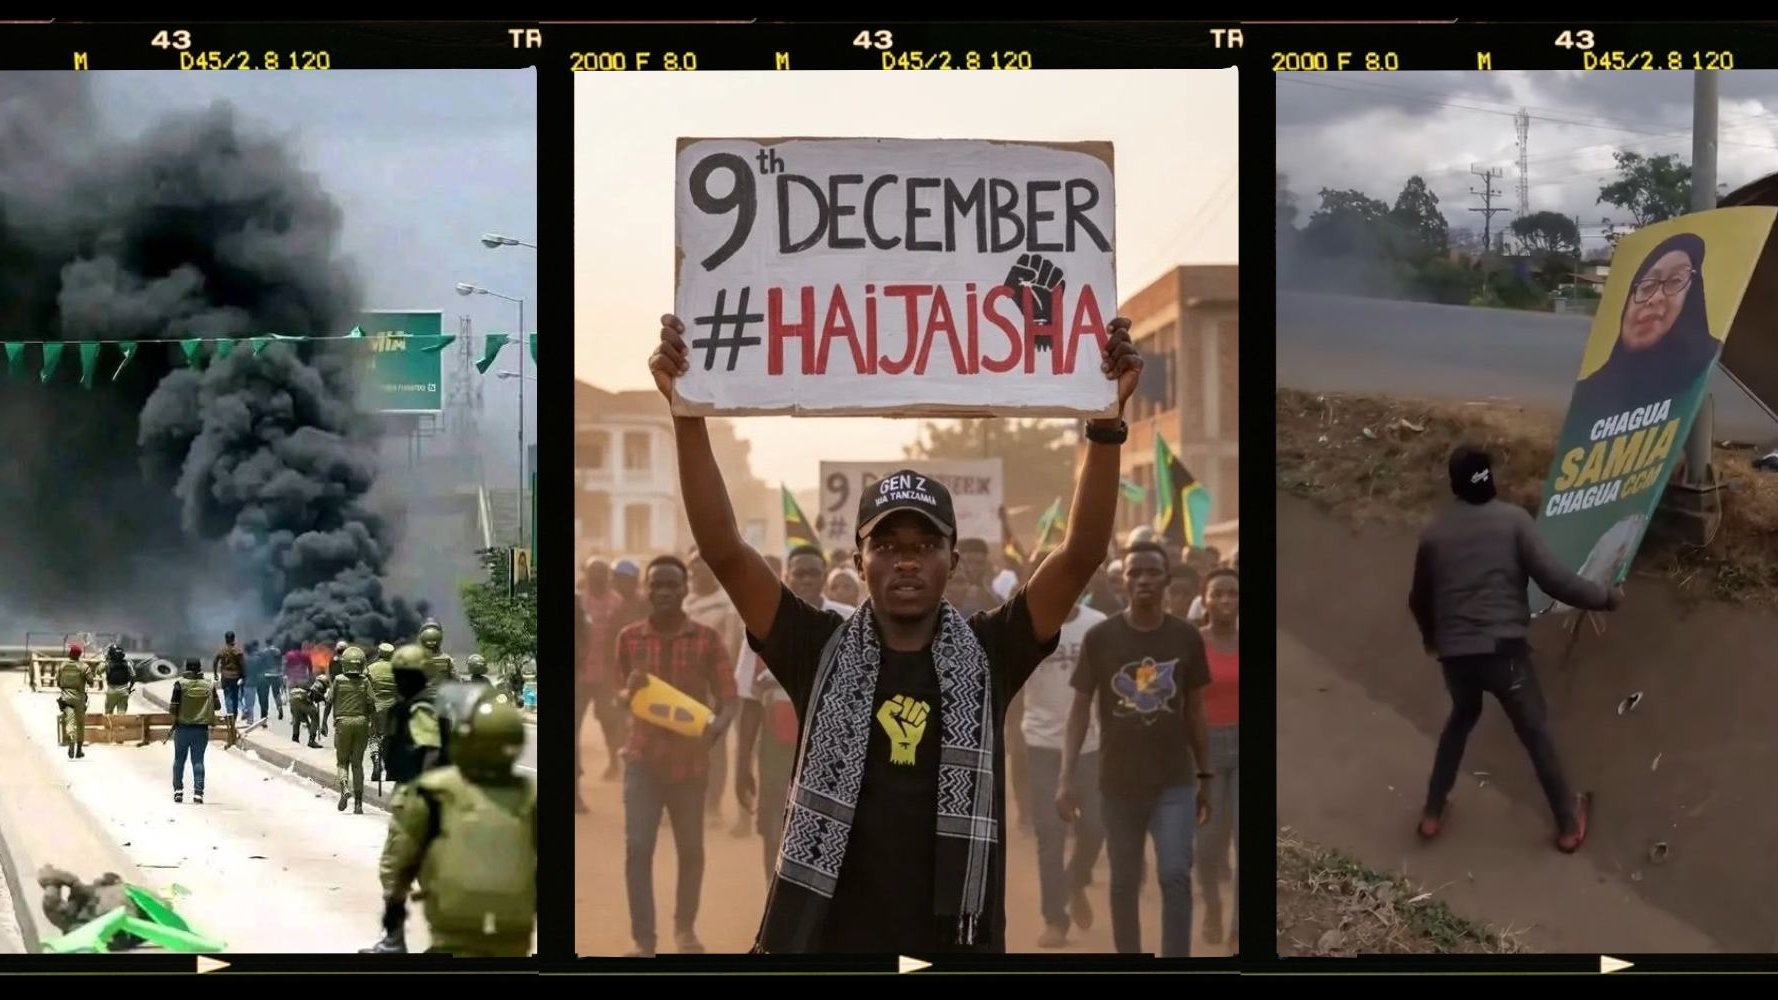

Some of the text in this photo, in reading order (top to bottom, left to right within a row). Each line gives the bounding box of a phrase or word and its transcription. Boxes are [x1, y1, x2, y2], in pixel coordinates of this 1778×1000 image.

[689, 148, 1113, 272] 9th DECEMBER
[1590, 399, 1672, 441] CHAGUA
[1554, 418, 1680, 491] SAMIA
[826, 471, 849, 512] 9
[880, 475, 911, 494] GEN
[916, 477, 926, 491] Z
[1545, 462, 1664, 517] CHAGUA CCM
